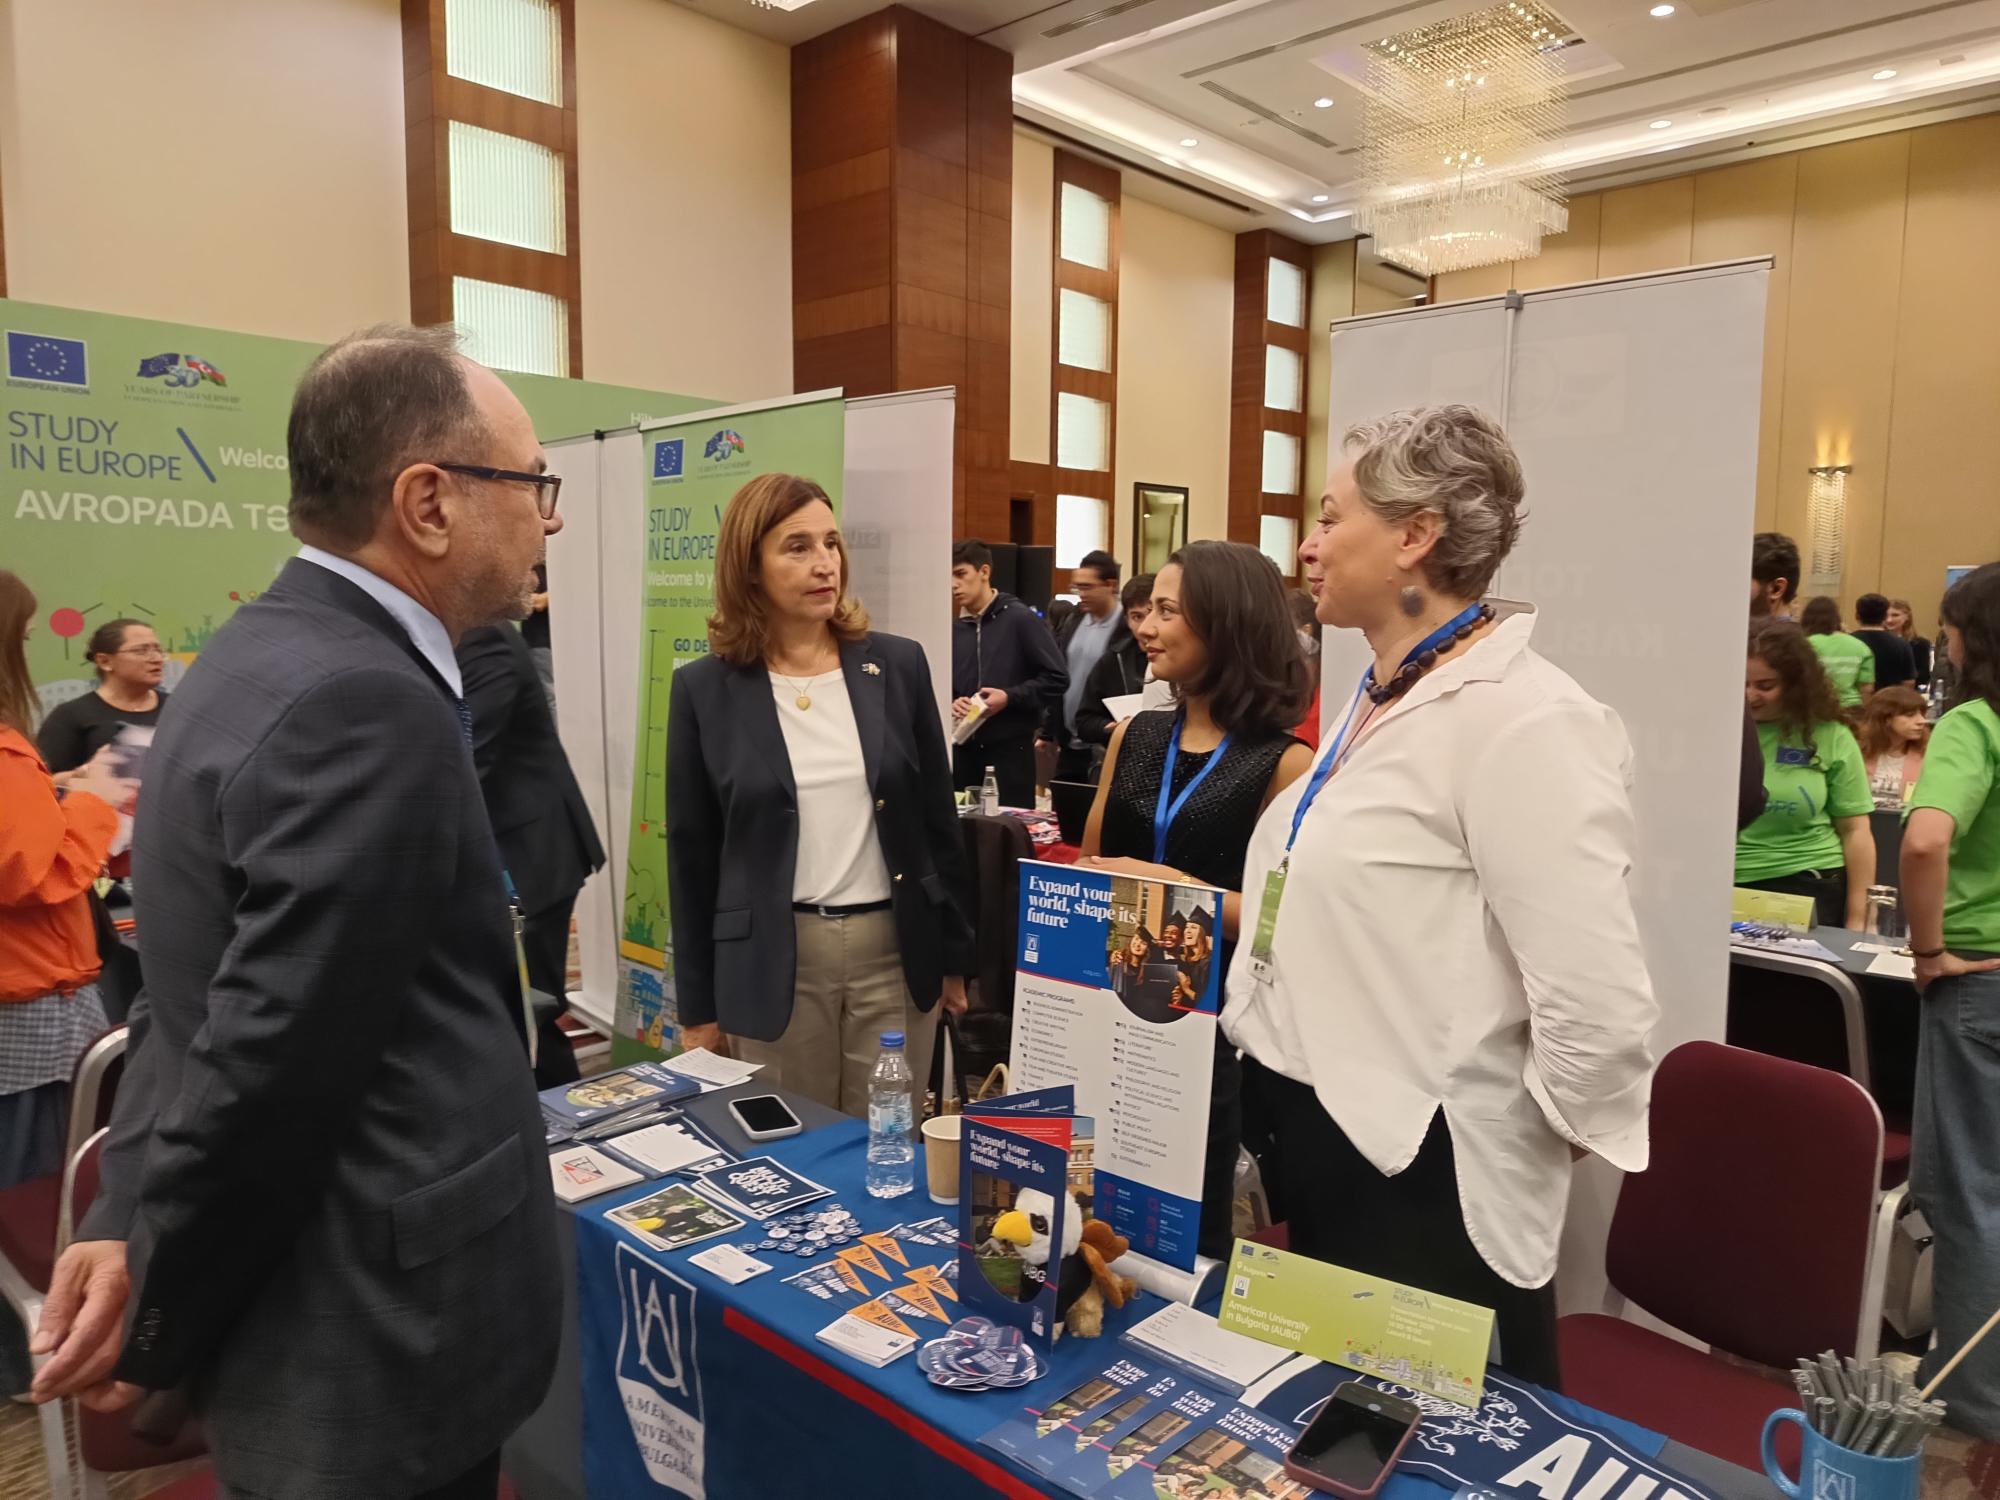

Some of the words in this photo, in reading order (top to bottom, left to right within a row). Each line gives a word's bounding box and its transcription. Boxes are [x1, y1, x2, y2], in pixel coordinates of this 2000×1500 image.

[6, 378, 59, 393] EUROPEAN
[61, 385, 91, 396] UNION
[8, 410, 119, 445] STUDY
[11, 443, 45, 471] IN
[58, 447, 183, 481] EUROPE
[15, 489, 234, 530] AVROPADA
[649, 507, 692, 533] STUDY
[663, 535, 715, 561] EUROPE
[647, 571, 693, 587] Welcome
[694, 571, 705, 587] to
[673, 638, 691, 652] GO
[1029, 875, 1080, 897] Expand
[1082, 887, 1116, 903] your
[1027, 907, 1069, 929] future
[1028, 895, 1071, 915] world,
[1073, 900, 1116, 922] shape
[1118, 906, 1137, 924] its
[970, 1130, 1006, 1149] Expand
[1007, 1143, 1031, 1157] your
[970, 1142, 1001, 1160] world,
[1002, 1151, 1031, 1169] shape
[1032, 1160, 1046, 1174] its
[970, 1151, 1000, 1170] future
[727, 1171, 767, 1195] QUEST
[740, 1169, 788, 1194] TALENT
[1226, 1310, 1234, 1320] in
[1236, 1313, 1270, 1331] Bulgaria
[1271, 1324, 1302, 1343] (AUBG)
[1228, 1300, 1267, 1320] American
[1269, 1311, 1311, 1334] University
[625, 1394, 696, 1443] AMERICAN
[1216, 1418, 1256, 1441] future
[1225, 1413, 1262, 1437] world,
[1230, 1407, 1280, 1434] Expand
